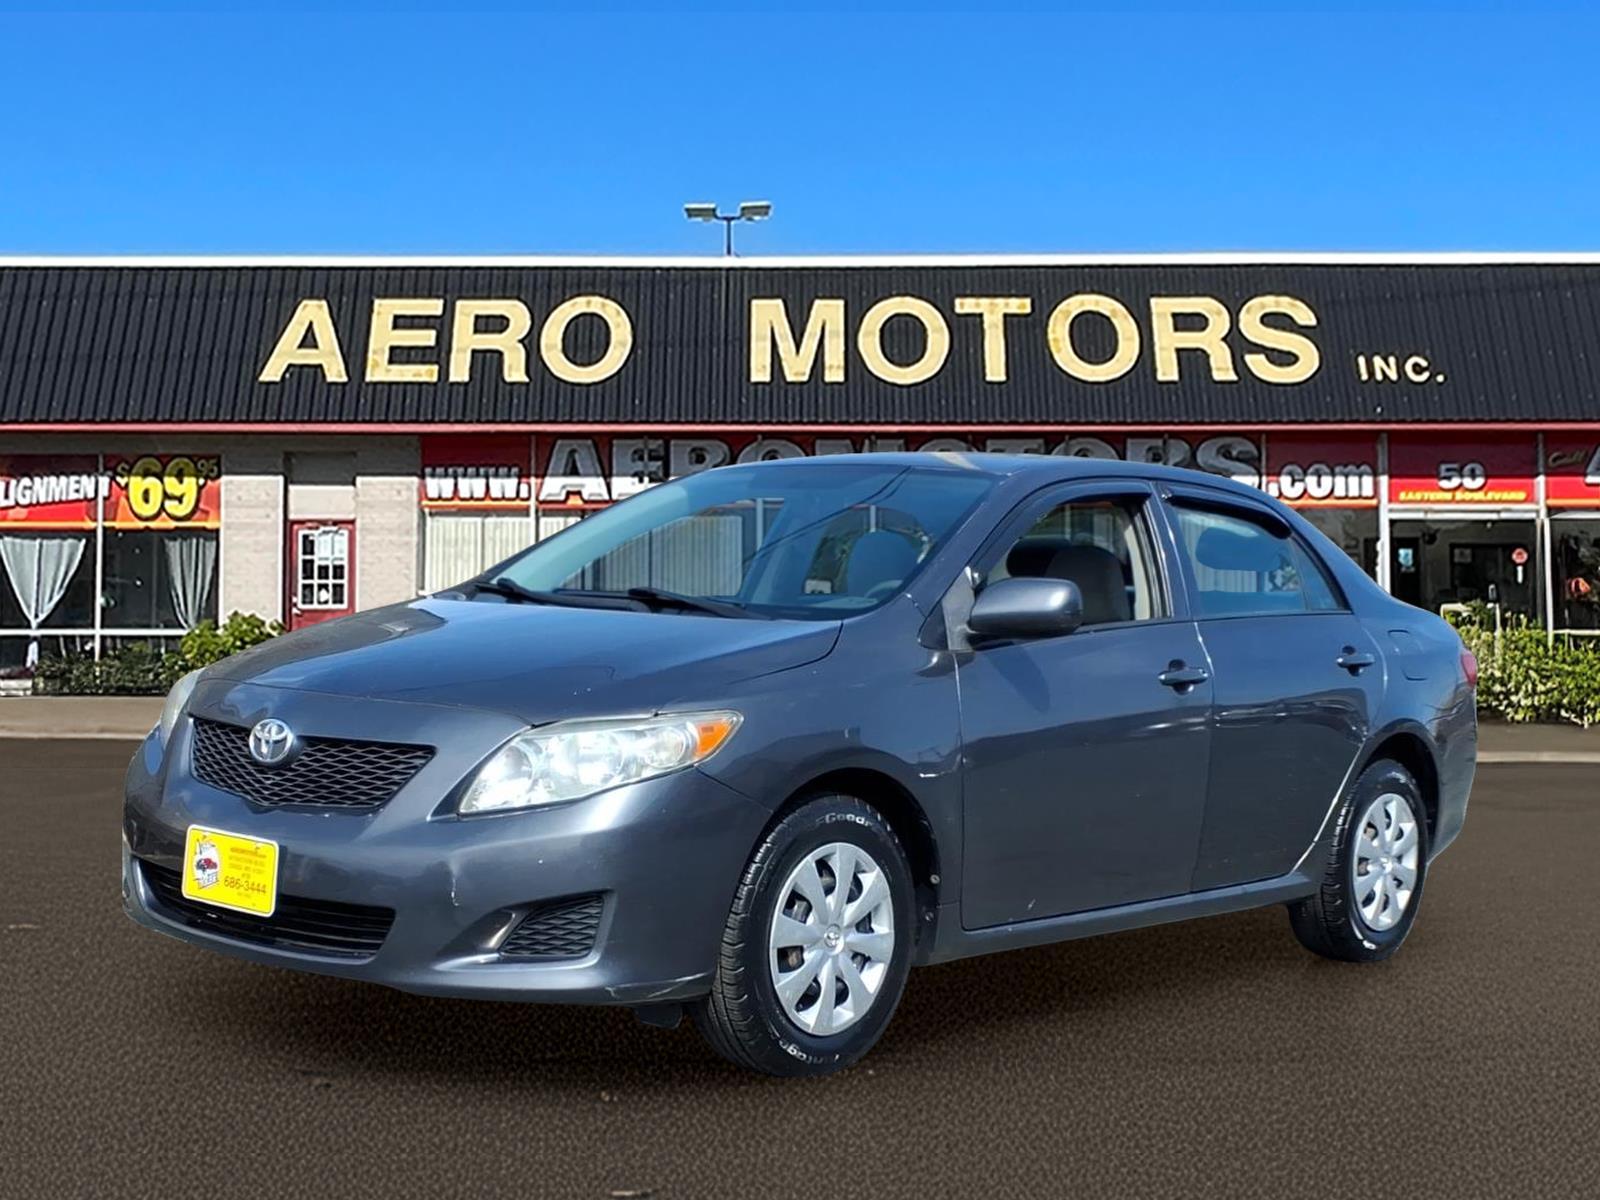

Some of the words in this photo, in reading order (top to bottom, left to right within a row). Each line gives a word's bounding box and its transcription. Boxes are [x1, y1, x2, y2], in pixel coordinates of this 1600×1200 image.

[258, 296, 633, 384] AERO
[749, 294, 1320, 386] MOTORS
[1356, 354, 1447, 384] INC.
[1437, 462, 1486, 490] 50
